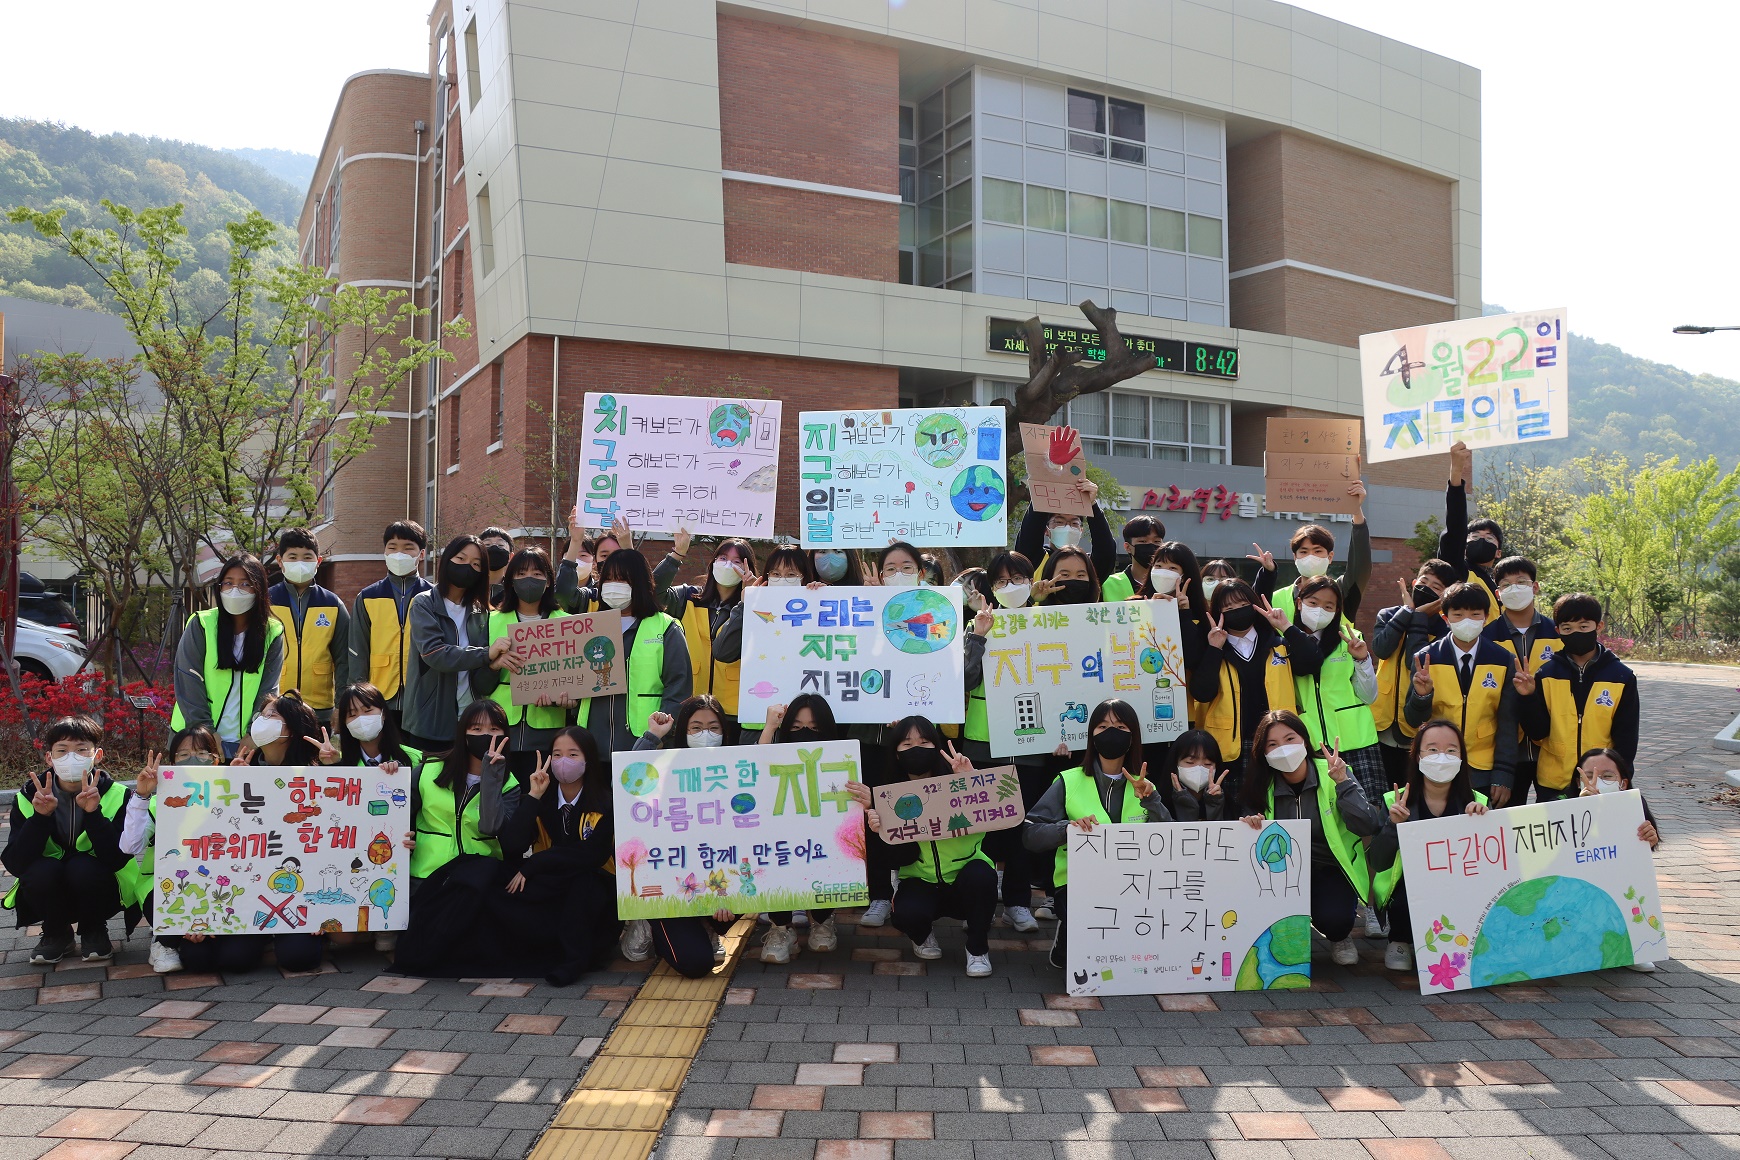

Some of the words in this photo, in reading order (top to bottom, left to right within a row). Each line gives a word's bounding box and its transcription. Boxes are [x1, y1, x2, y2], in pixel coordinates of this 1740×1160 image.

[1004, 338, 1029, 352] 자세
[1057, 330, 1077, 343] 보면
[1081, 333, 1101, 346] 모든
[1137, 338, 1156, 353] 좋다
[1196, 347, 1237, 376] 8:42
[1513, 386, 1556, 440] 날
[671, 484, 717, 501] 위해
[872, 494, 910, 510] 위해
[1141, 484, 1258, 524] 미래역량을
[625, 508, 664, 526] 한번
[671, 508, 763, 528] 구해보던가!
[782, 596, 875, 627] 우리는
[991, 613, 1029, 639] 환경을
[1033, 611, 1070, 630] 지키는
[1086, 606, 1111, 625] 착한
[1116, 605, 1141, 625] 실천
[514, 623, 555, 643] CARE
[560, 617, 594, 637] FOR
[516, 639, 577, 660] EARTH
[799, 634, 857, 662] 지구
[1110, 630, 1141, 692] 날
[515, 660, 561, 676] 아프지마
[562, 655, 585, 671] 지구
[516, 681, 530, 692] 4월
[532, 679, 549, 690] 22일
[551, 675, 574, 688] 지구의
[576, 673, 585, 687] 날
[800, 669, 892, 702] 지킴이
[1146, 722, 1164, 733] 텀블러
[1165, 720, 1183, 732] USE
[671, 759, 760, 794] 깨끗한
[768, 747, 859, 818] 지구
[949, 777, 968, 793] 초록
[970, 773, 997, 788] 지구
[182, 779, 266, 814] 지구는
[949, 790, 990, 809] 아껴요
[629, 792, 761, 833] 아름다운
[972, 803, 1018, 824] 지켜요
[886, 823, 929, 842] 지구의
[928, 816, 942, 837] 날
[1425, 826, 1508, 877] 다같이
[1512, 809, 1592, 854] 지키자!
[182, 830, 283, 862] 기후위기는
[646, 844, 687, 871] 우리
[697, 842, 738, 871] 함께
[752, 838, 829, 867] 만들어요
[1075, 827, 1240, 861] 지금이라도
[1575, 845, 1618, 864] EARTH
[814, 891, 870, 904] CATCHER
[823, 881, 868, 894] GREEN
[1119, 868, 1206, 902] 지구를
[1087, 906, 1238, 942] 구하자!
